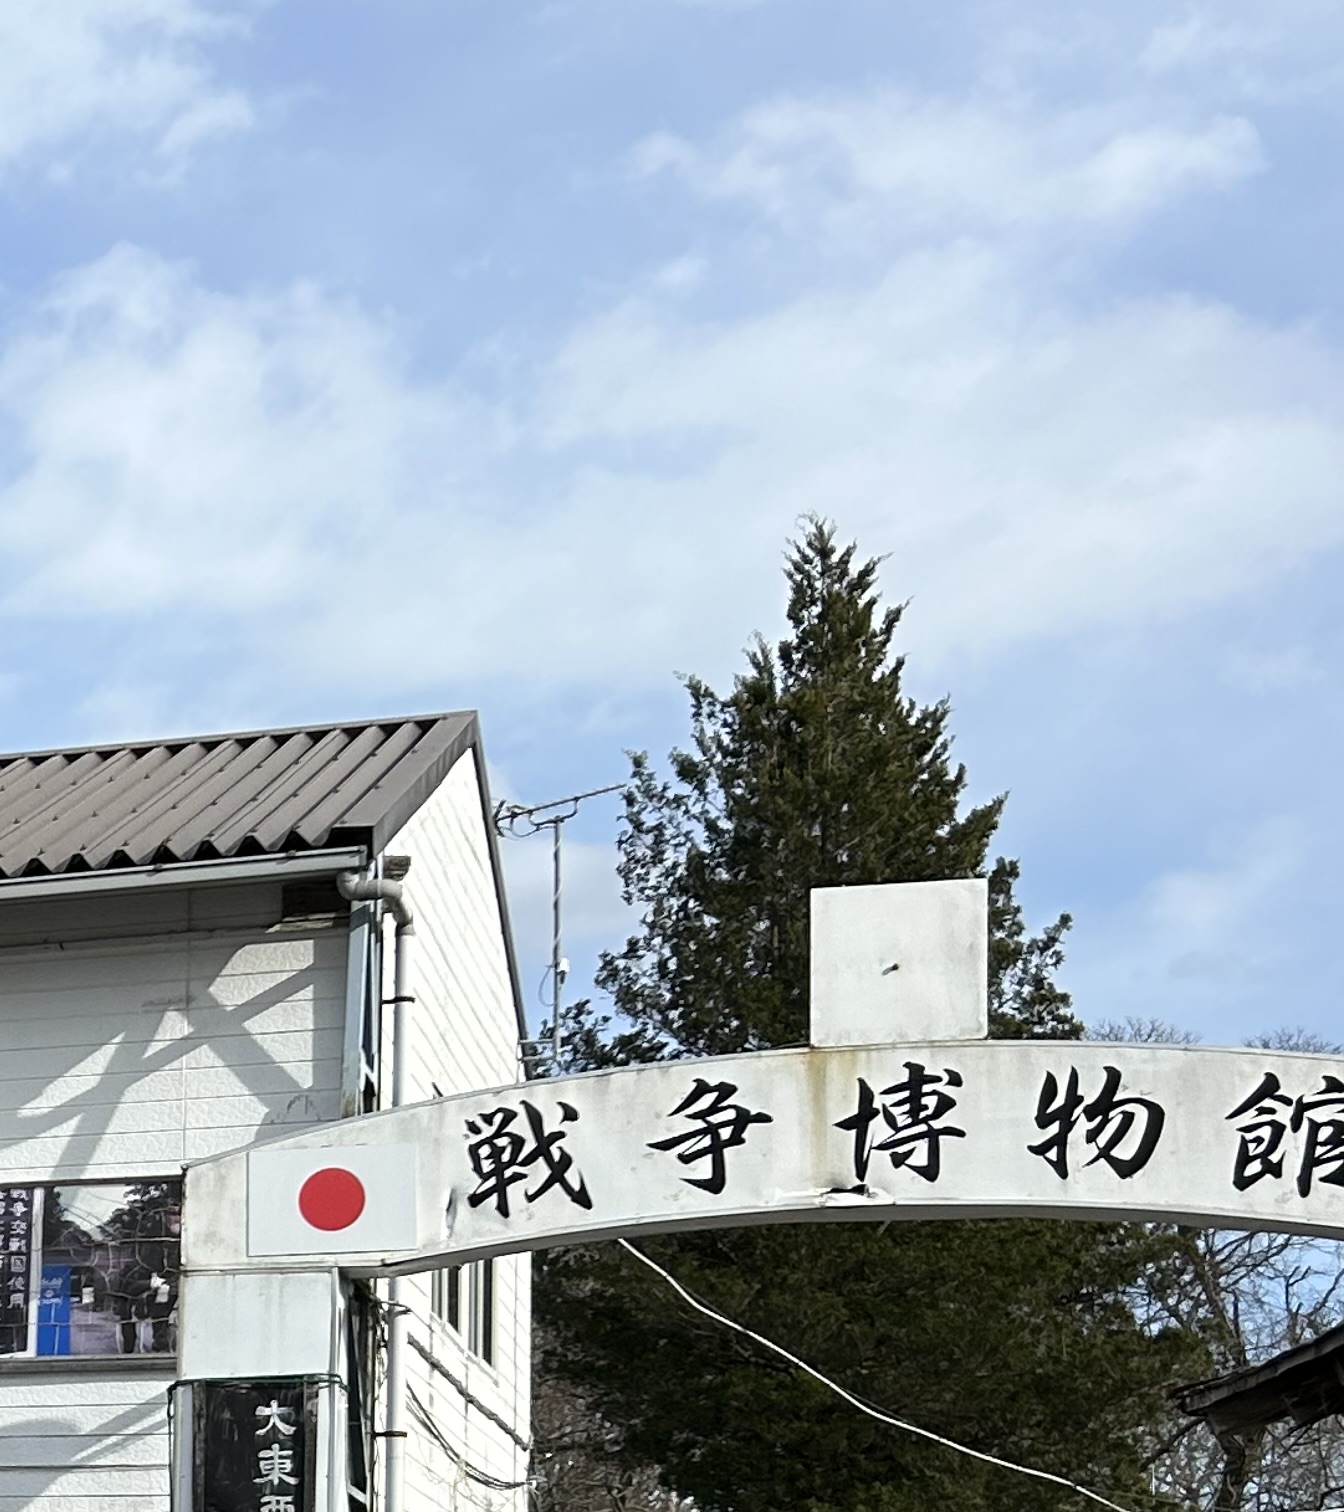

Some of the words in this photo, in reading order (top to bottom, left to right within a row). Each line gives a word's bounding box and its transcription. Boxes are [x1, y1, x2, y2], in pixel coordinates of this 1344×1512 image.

[464, 1060, 1344, 1219] 戦争博物館
